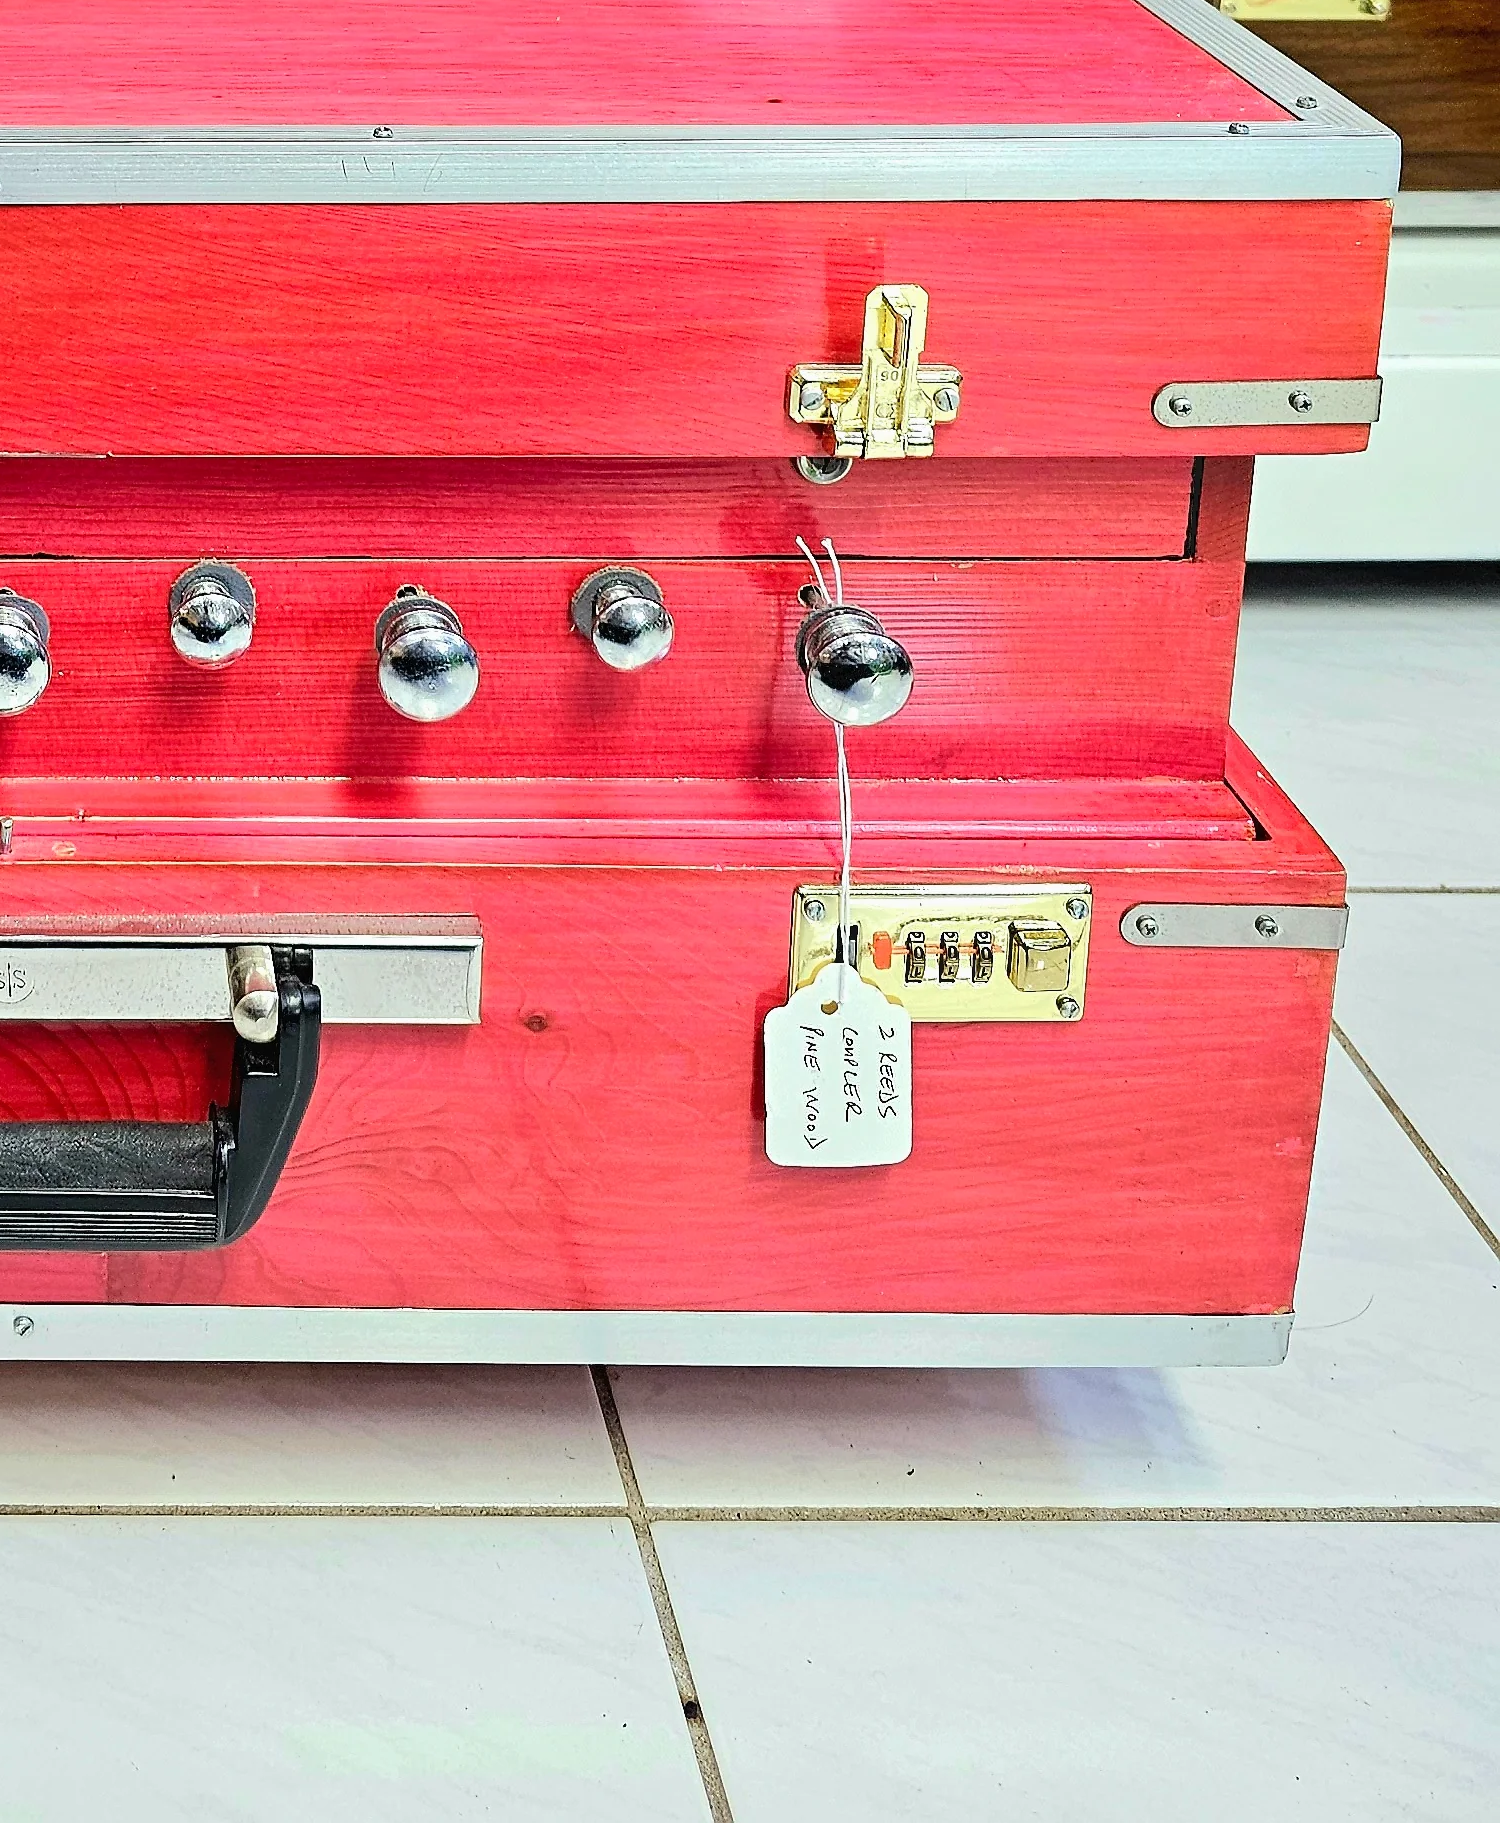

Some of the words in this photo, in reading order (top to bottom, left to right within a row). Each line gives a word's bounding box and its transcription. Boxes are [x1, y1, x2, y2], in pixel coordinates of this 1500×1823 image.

[799, 1025, 825, 1072] PINE
[878, 1024, 895, 1041] 2
[841, 1026, 863, 1123] COUPLER
[877, 1051, 900, 1120] REEDS
[802, 1086, 828, 1150] WOOD
